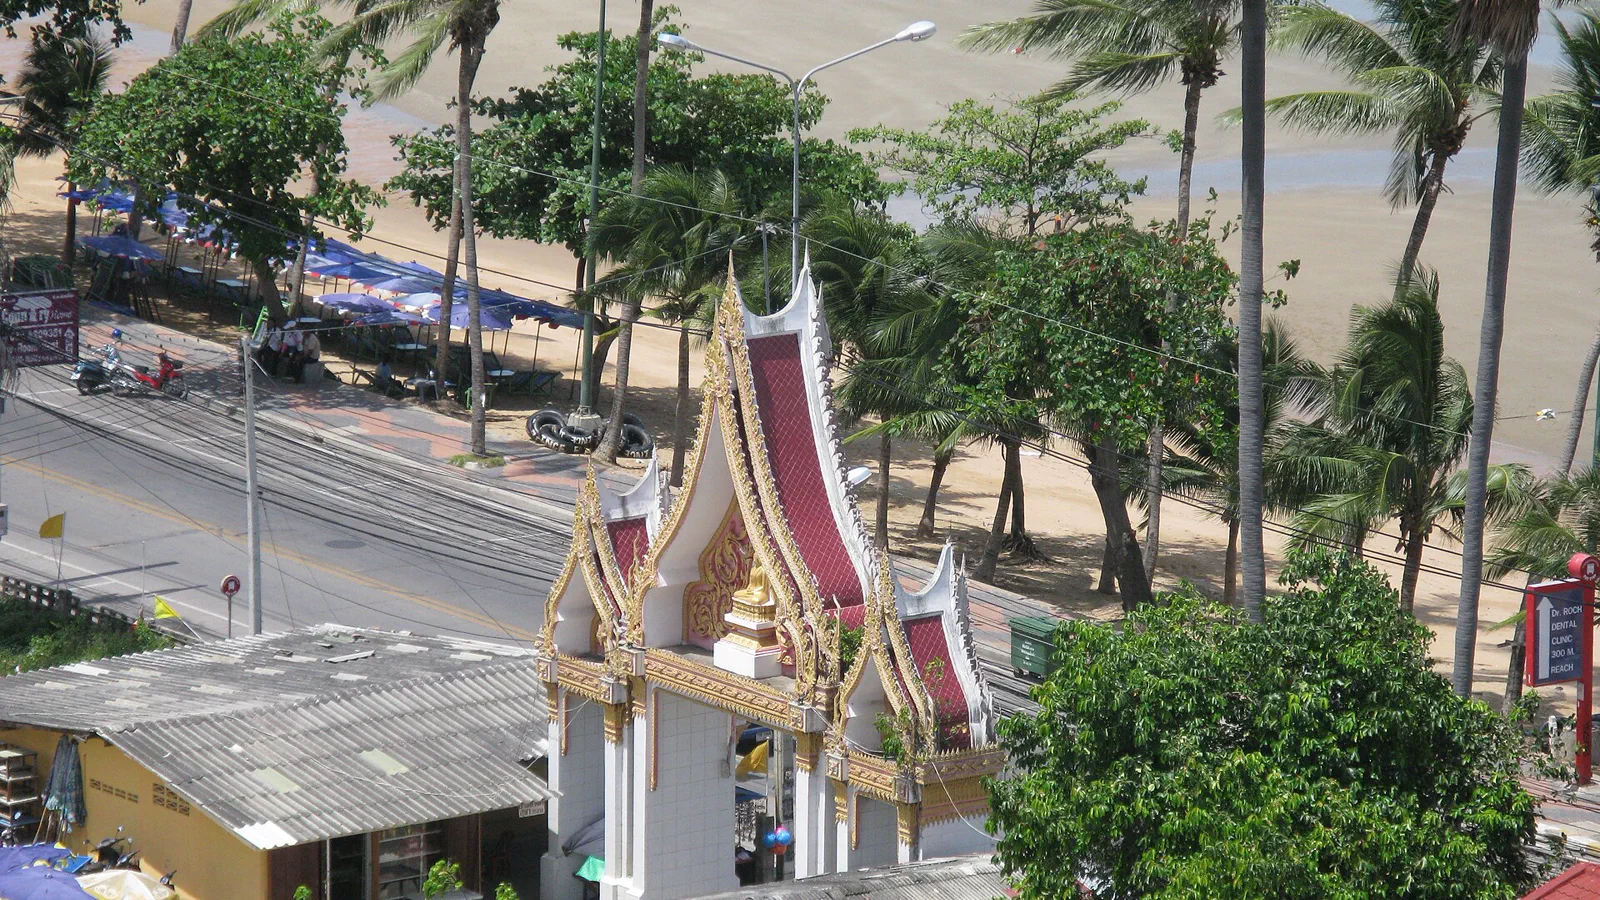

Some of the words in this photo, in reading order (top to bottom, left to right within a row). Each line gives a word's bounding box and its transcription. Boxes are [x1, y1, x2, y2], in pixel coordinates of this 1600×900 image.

[1551, 609, 1562, 617] Dr.
[1563, 606, 1582, 615] ROCH
[1551, 620, 1577, 631] DENTAL
[1551, 635, 1573, 645] CLINIC
[1551, 649, 1565, 658] 300
